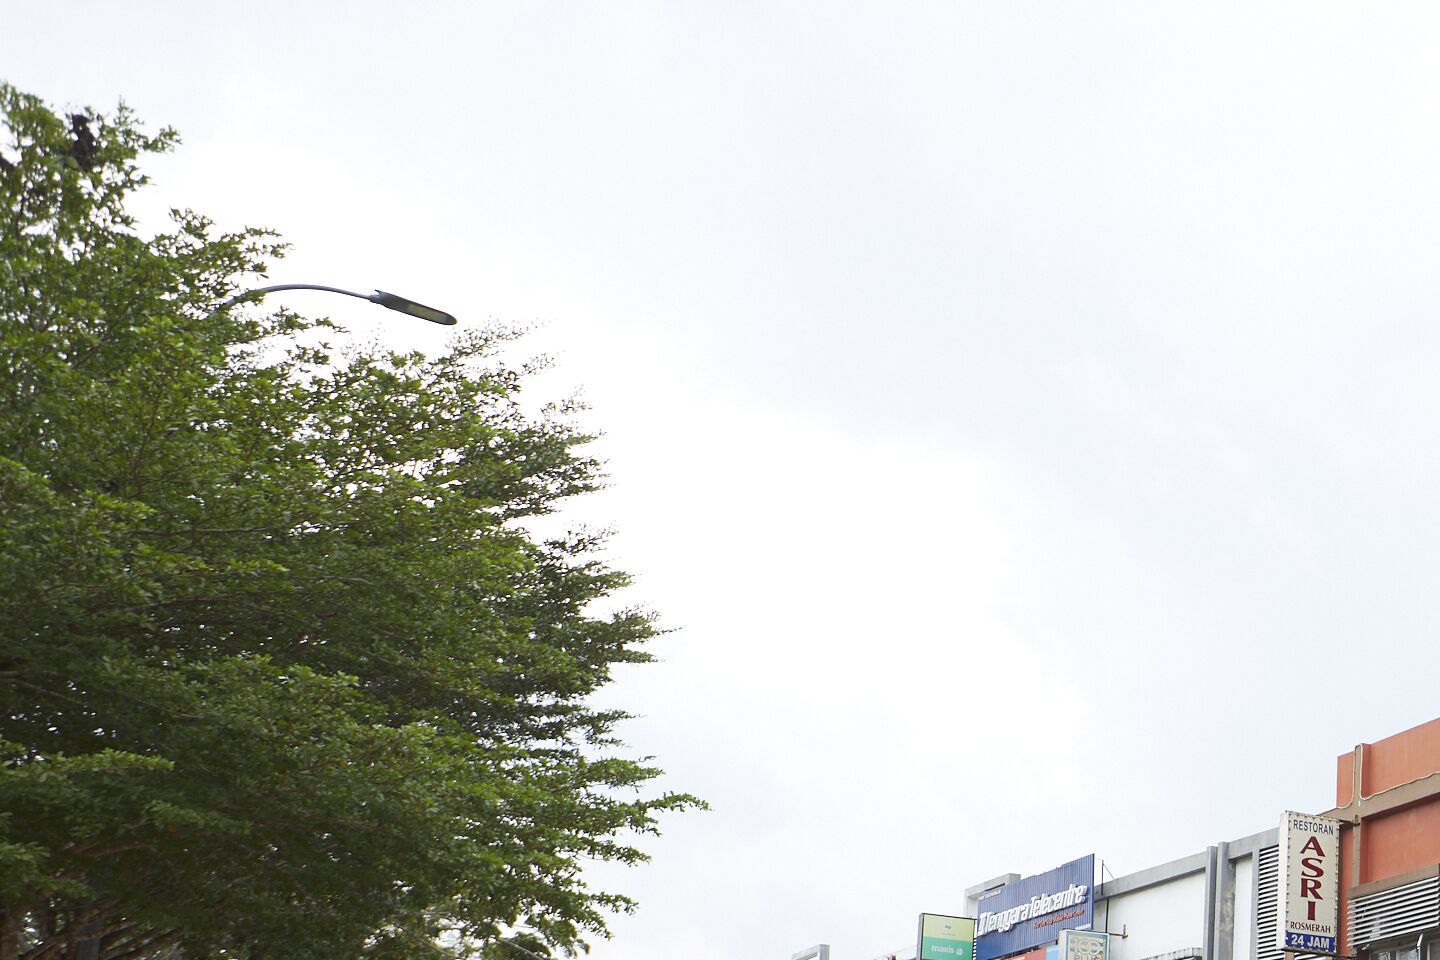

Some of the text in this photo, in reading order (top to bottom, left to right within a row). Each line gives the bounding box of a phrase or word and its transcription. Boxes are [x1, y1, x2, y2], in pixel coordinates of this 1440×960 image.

[1293, 819, 1334, 836] RESTORAN
[1299, 835, 1326, 921] ASRI
[1290, 920, 1331, 934] ROSMERAH
[931, 944, 954, 954] maxis
[1291, 933, 1330, 949] 24 JAM
